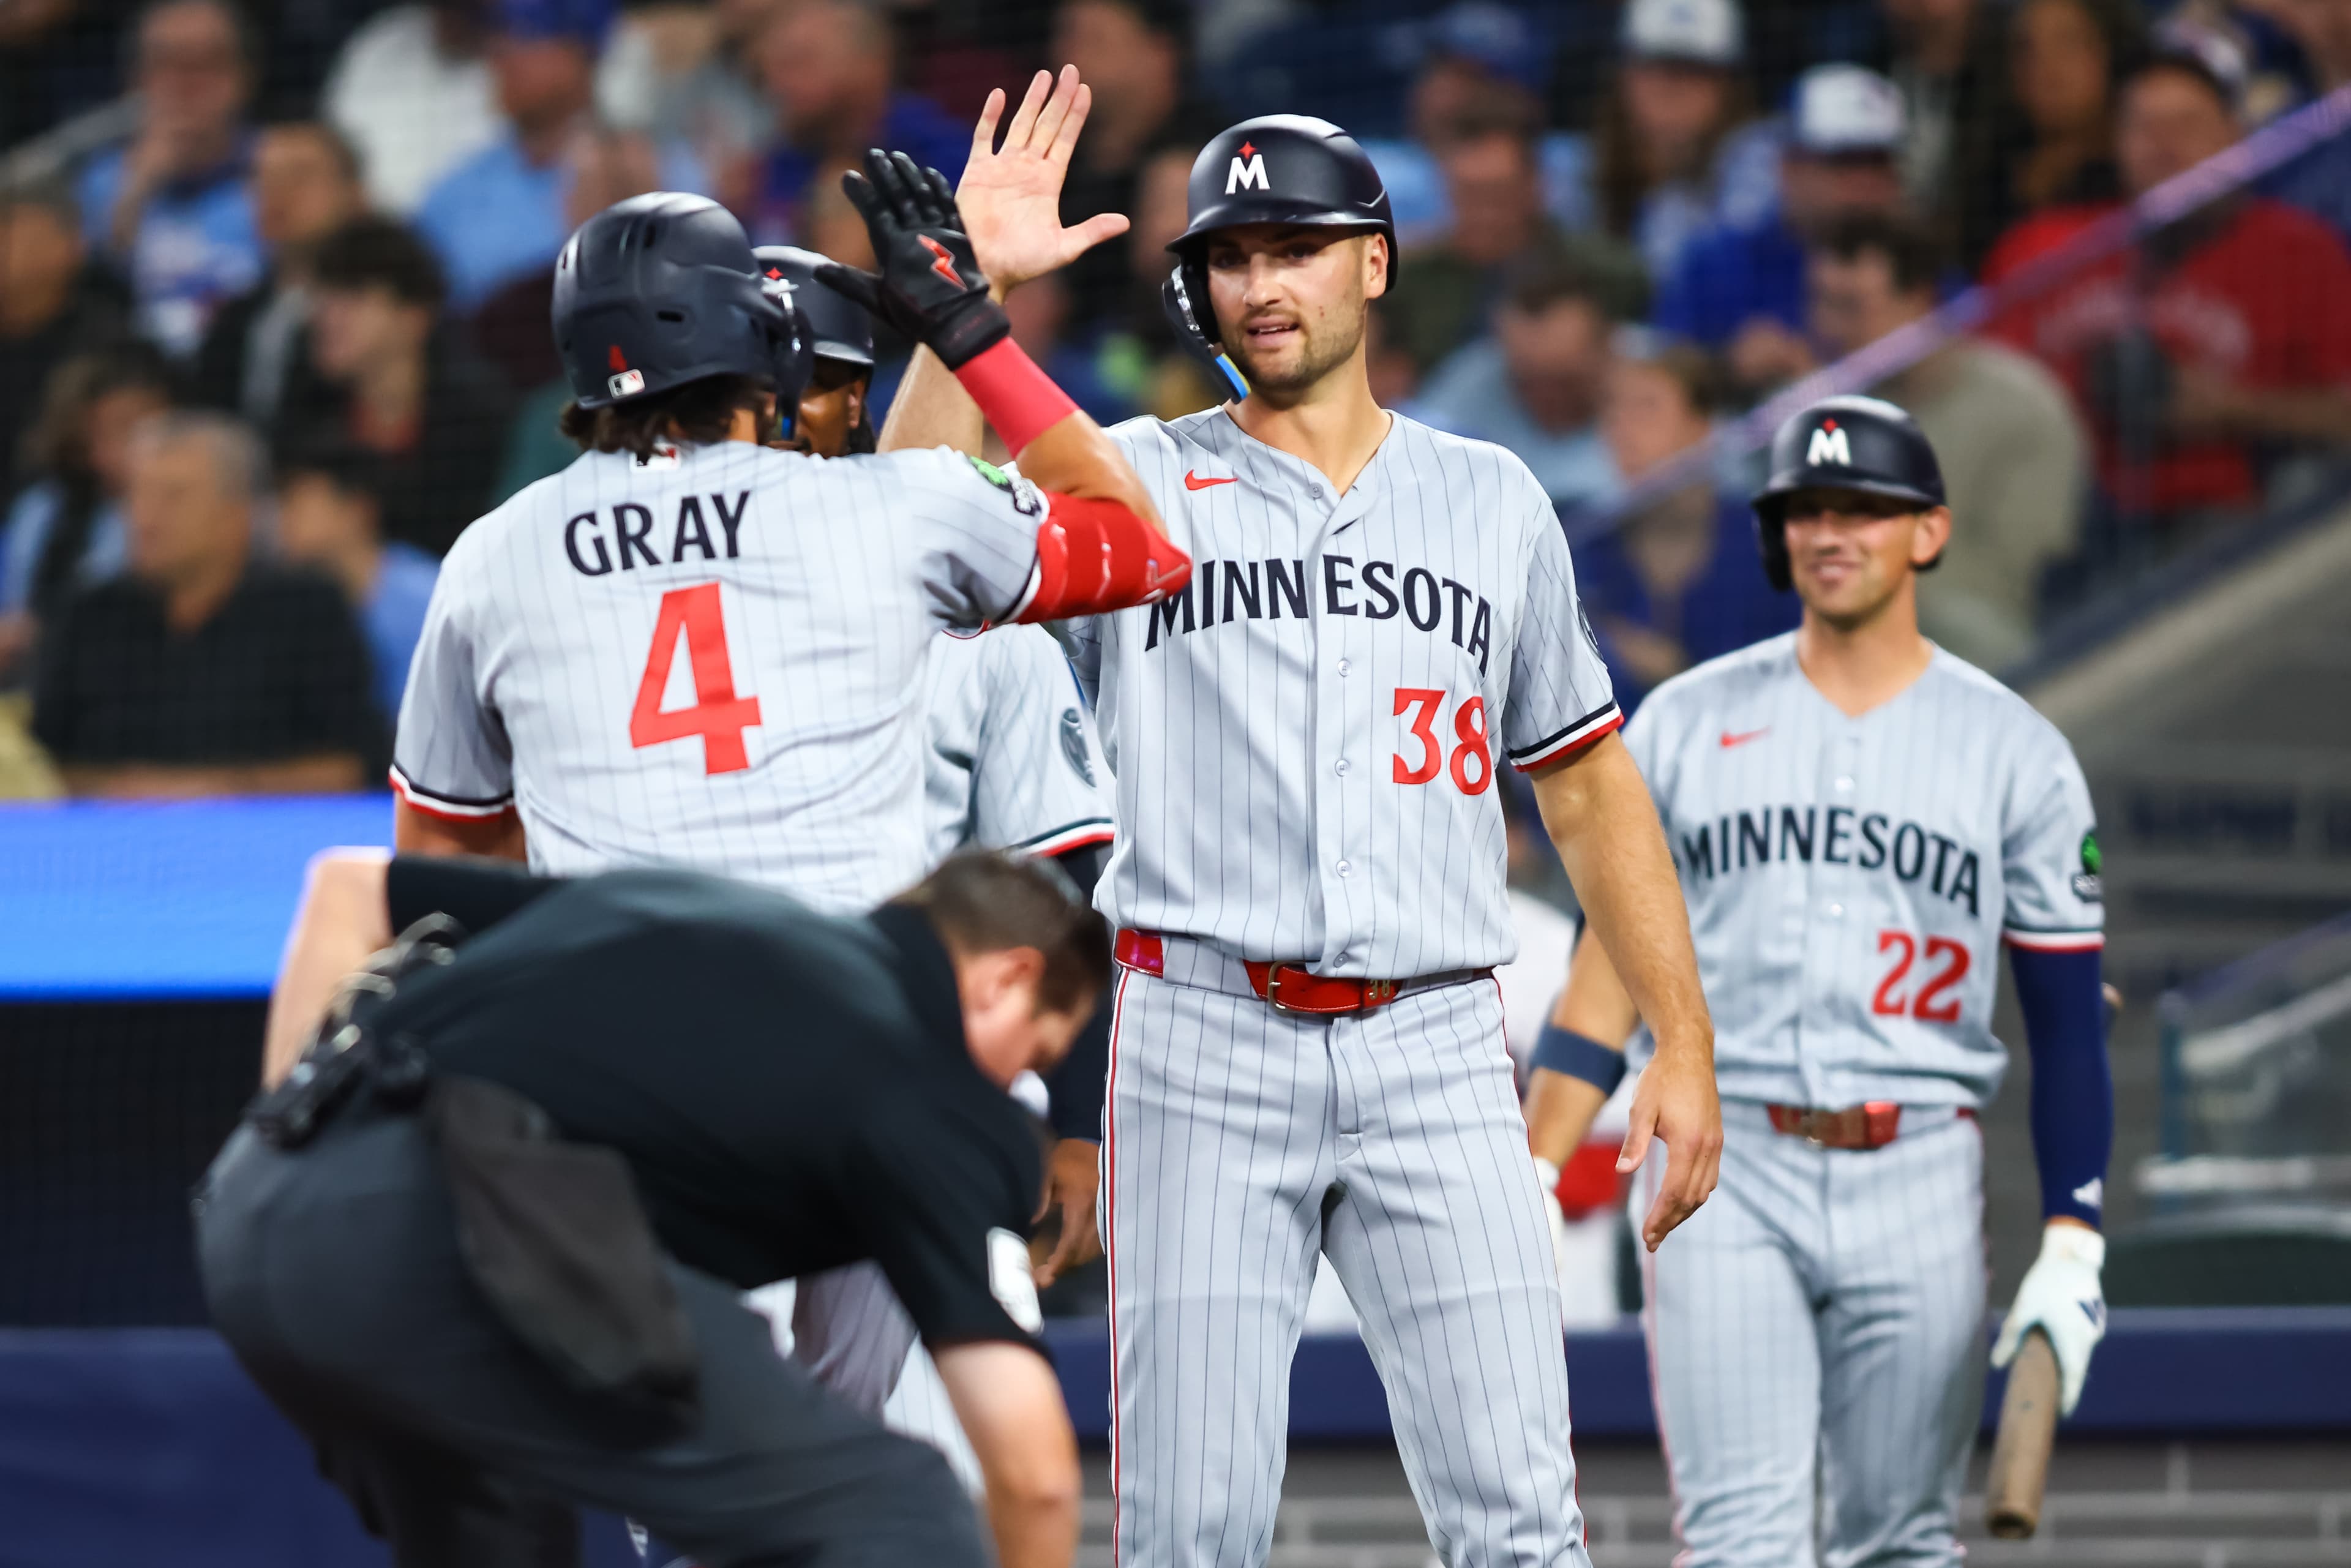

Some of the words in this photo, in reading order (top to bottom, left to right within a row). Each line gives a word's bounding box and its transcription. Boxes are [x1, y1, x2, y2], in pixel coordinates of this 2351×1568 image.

[1225, 153, 1270, 195] M
[1807, 428, 1851, 466] M
[564, 490, 751, 576] GRAY
[1144, 554, 1492, 678] MINNESOTA
[629, 582, 762, 775] 4
[1393, 688, 1492, 795] 38
[1674, 806, 1980, 918] MINNESOTA
[1872, 929, 1972, 1021] 22
